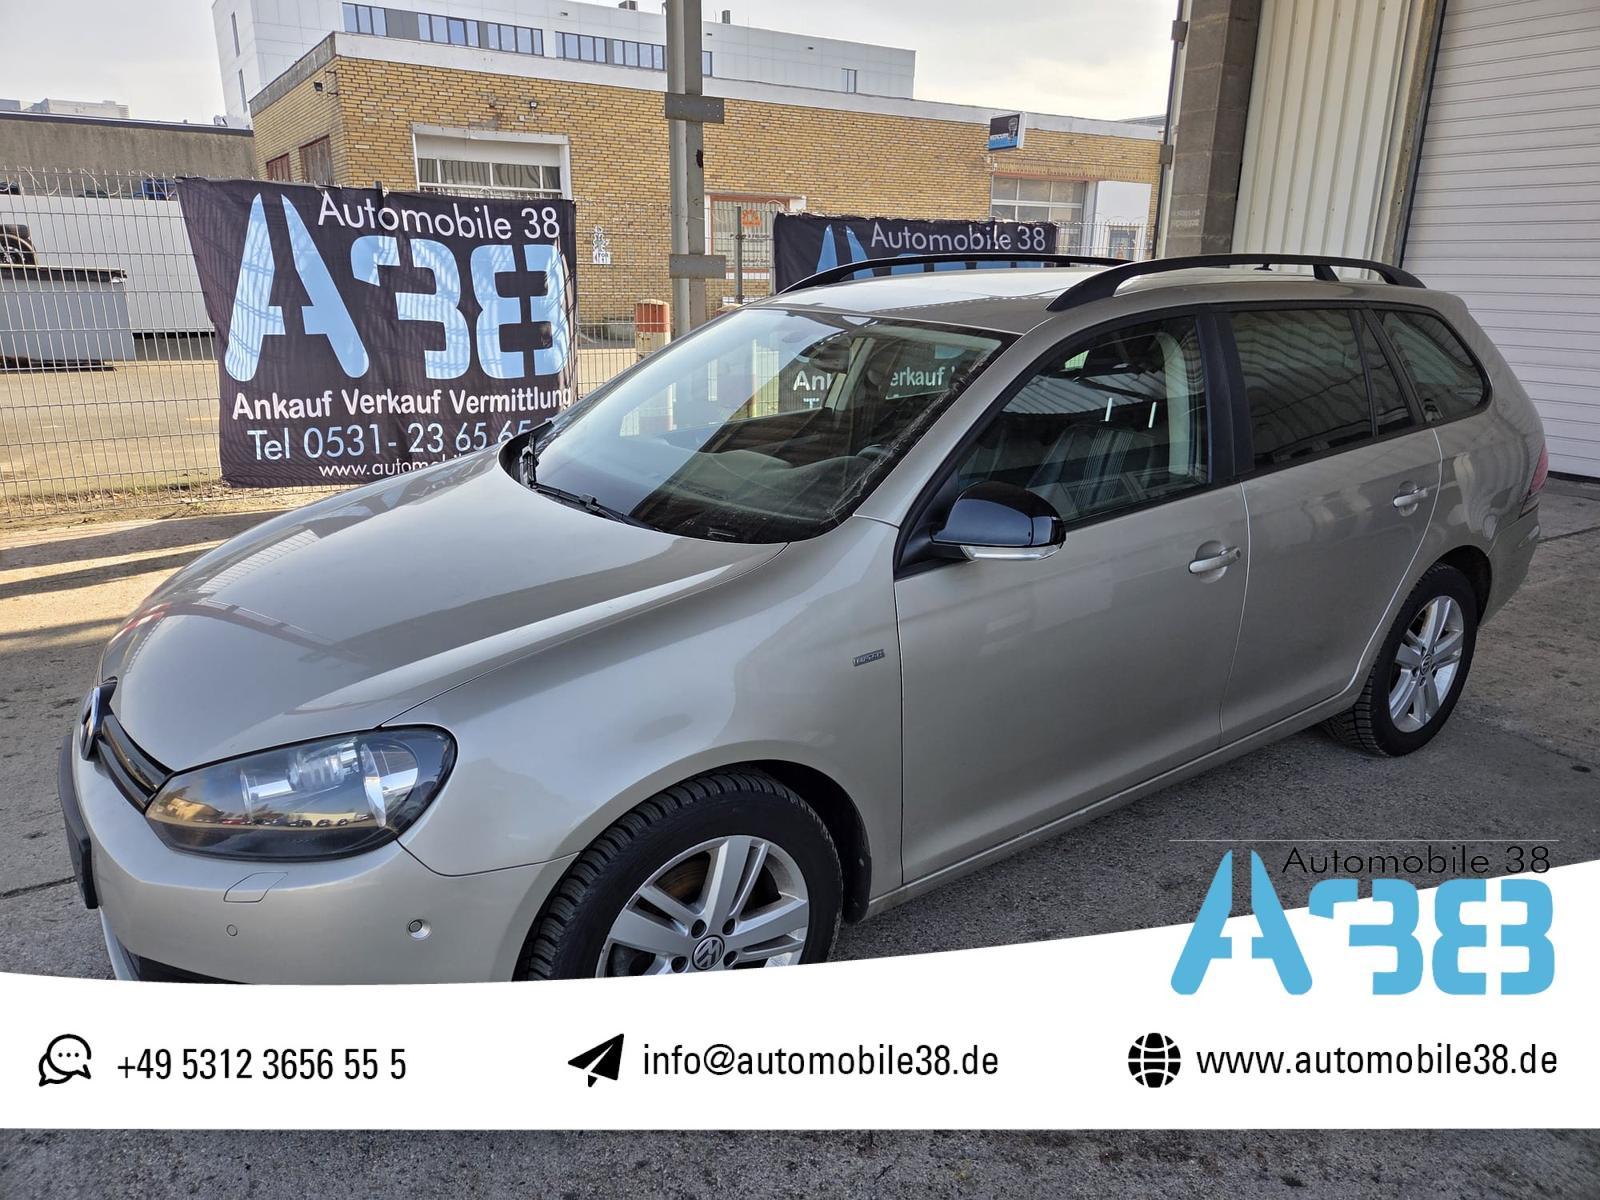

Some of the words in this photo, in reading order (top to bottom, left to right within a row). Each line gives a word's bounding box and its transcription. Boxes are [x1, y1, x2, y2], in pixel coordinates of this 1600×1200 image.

[318, 190, 512, 240] Automobile
[520, 206, 561, 239] 38
[871, 221, 1011, 251] Automobile
[1017, 225, 1046, 251] 38
[225, 192, 568, 382] A38
[889, 366, 946, 388] erkauf
[232, 389, 333, 420] Ankauf
[341, 388, 442, 416] Verkauf
[450, 386, 572, 412] Vermittlung
[247, 426, 291, 461] Tel
[407, 423, 445, 453] 23
[456, 421, 487, 451] 65
[318, 453, 462, 476] www.autom
